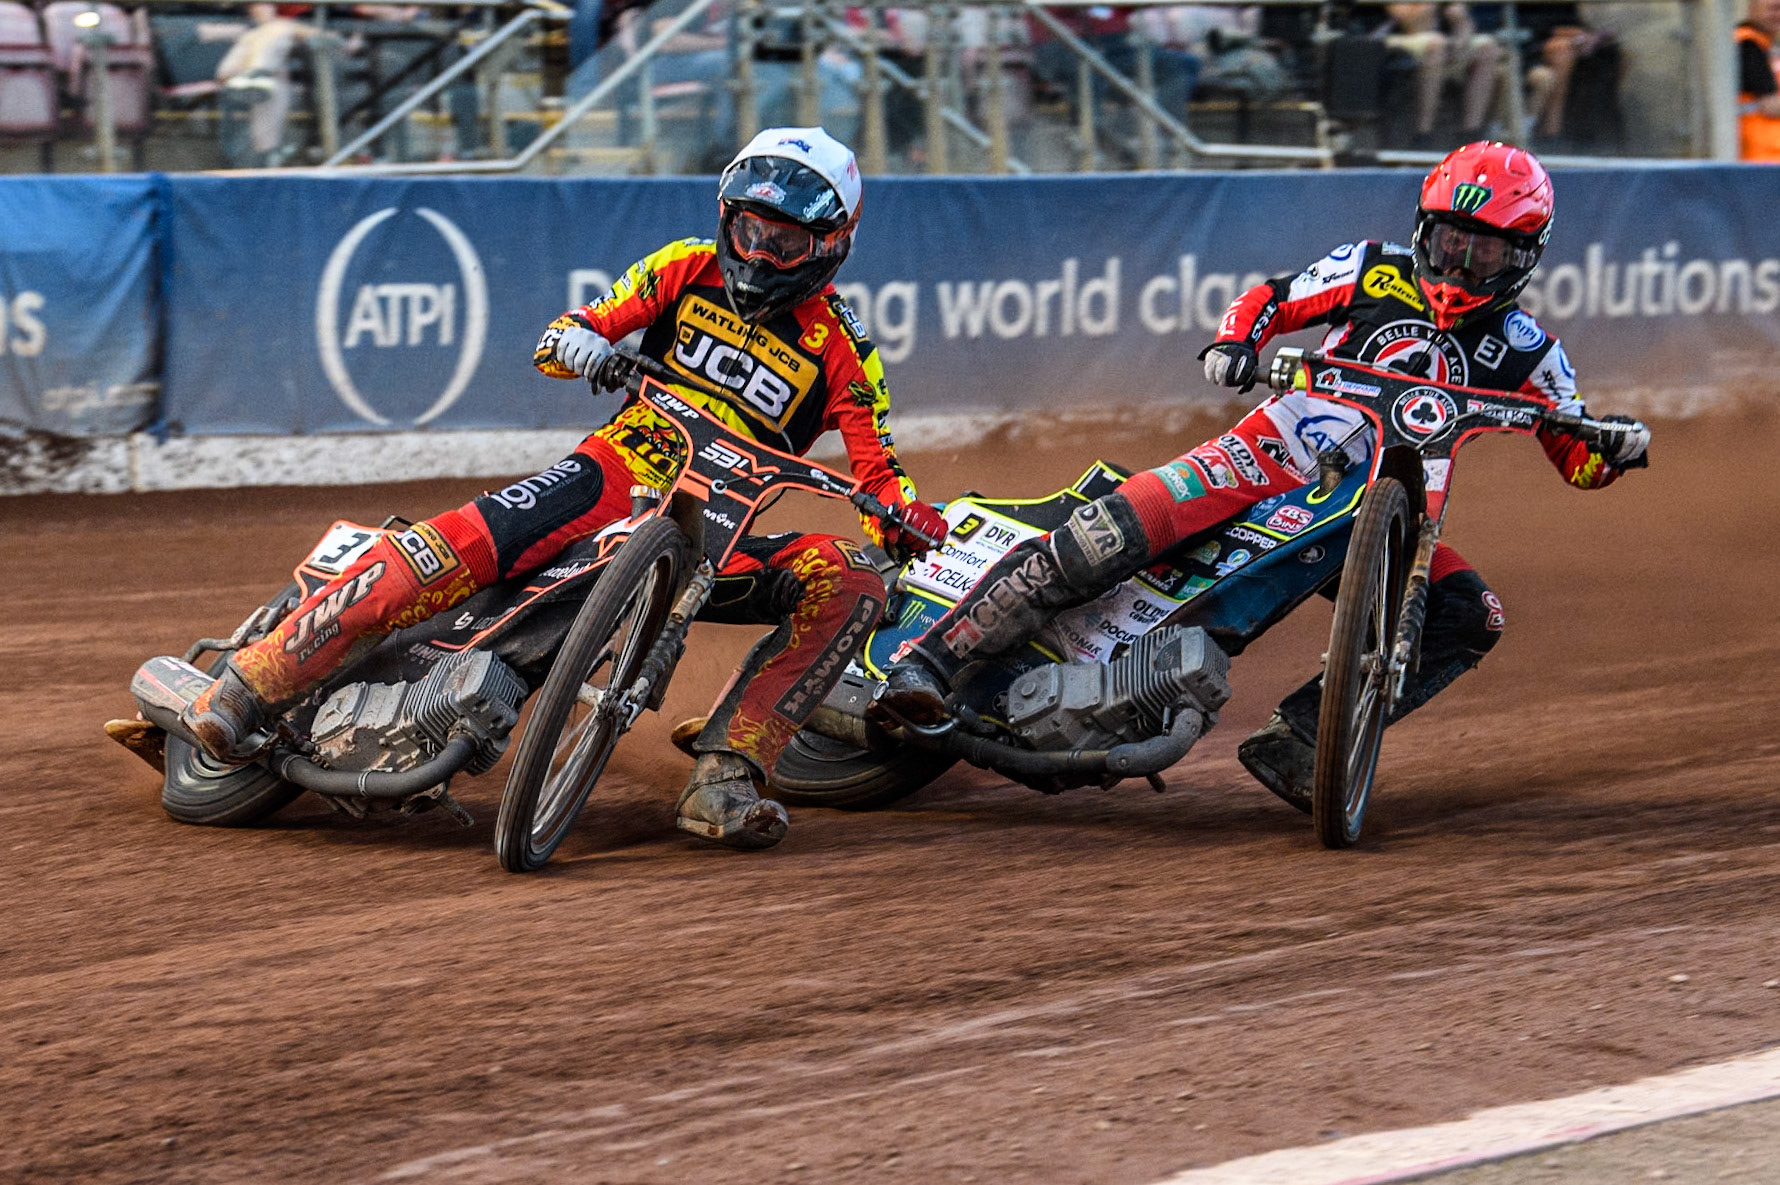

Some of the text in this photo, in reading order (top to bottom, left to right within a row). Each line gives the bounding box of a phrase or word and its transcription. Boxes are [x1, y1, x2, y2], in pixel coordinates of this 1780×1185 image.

[345, 284, 455, 347] ATPI
[937, 257, 1121, 339] world
[1142, 254, 1297, 333] cla
[692, 304, 801, 373] WATLING JCB
[804, 323, 828, 348] 3
[1376, 325, 1419, 346] BELLE
[675, 335, 791, 417] JCB
[655, 391, 700, 420] JWP
[955, 518, 980, 536] 3
[986, 526, 1016, 549] DVR
[1080, 505, 1117, 554] DVR
[940, 543, 986, 569] comfort
[284, 561, 386, 651] JWP
